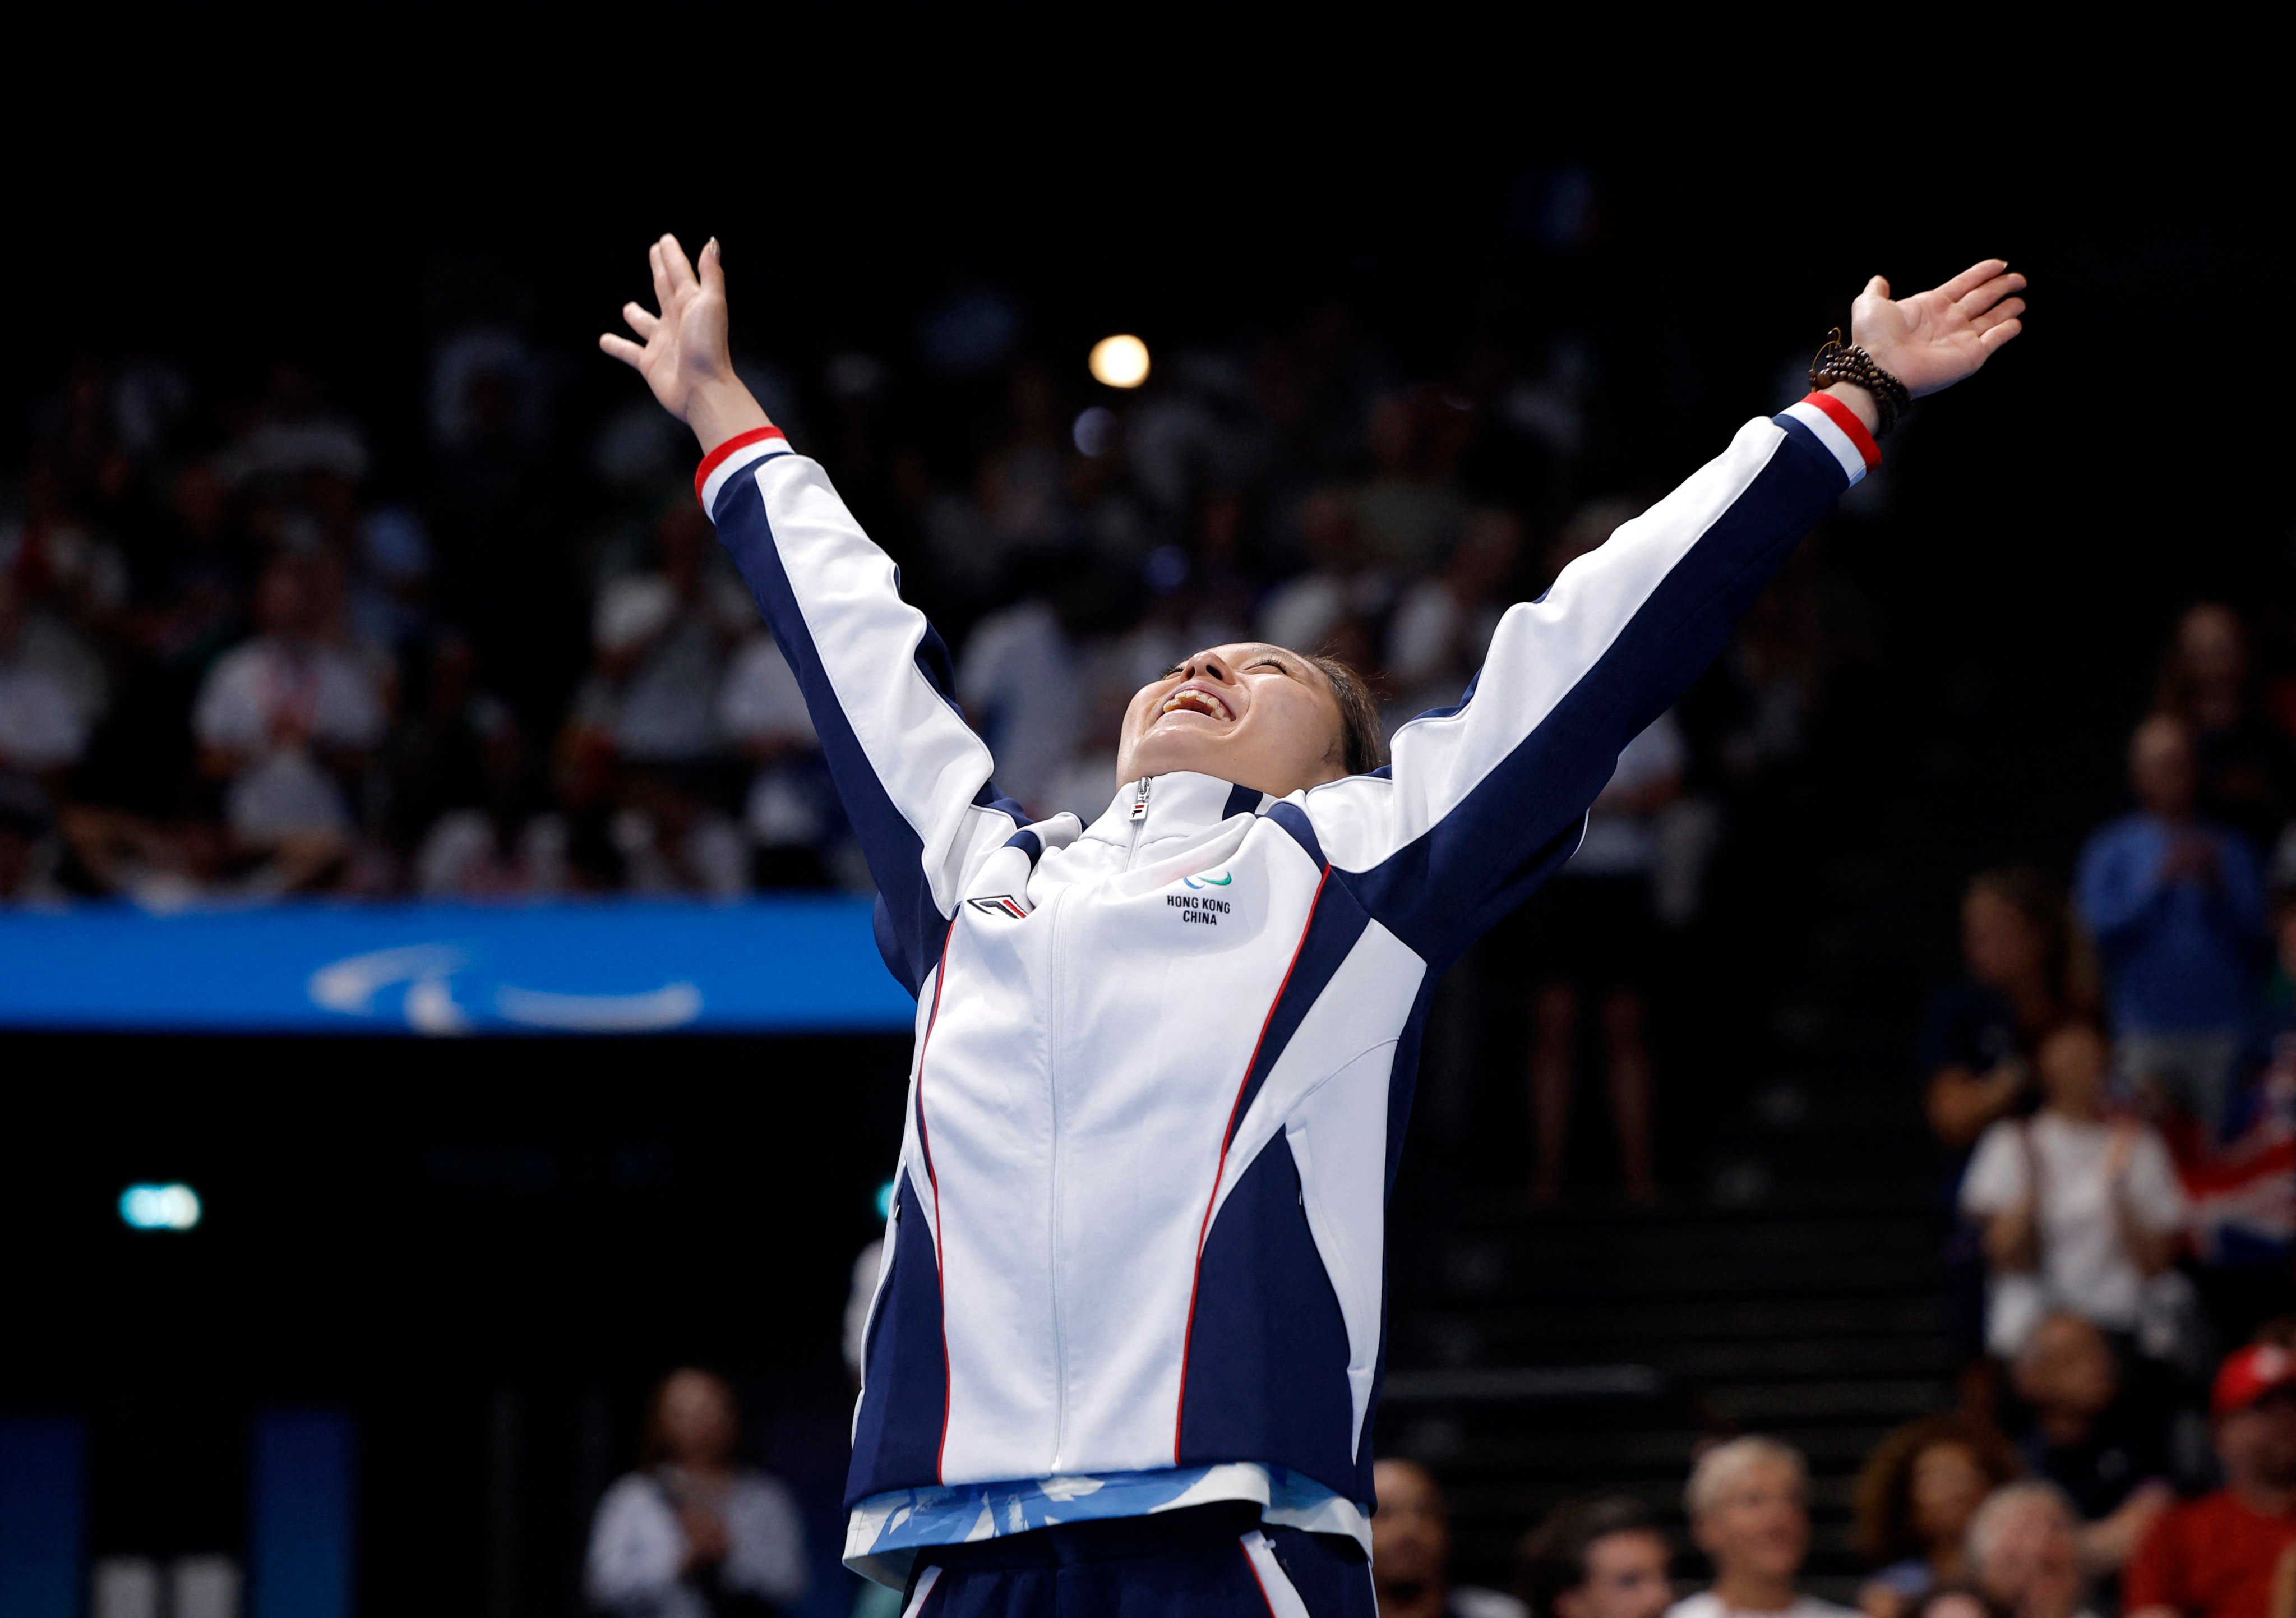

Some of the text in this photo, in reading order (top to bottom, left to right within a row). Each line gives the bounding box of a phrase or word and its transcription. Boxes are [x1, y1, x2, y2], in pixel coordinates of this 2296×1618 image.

[1167, 895, 1230, 914] HONG KONG
[1183, 910, 1217, 925] CHINA
